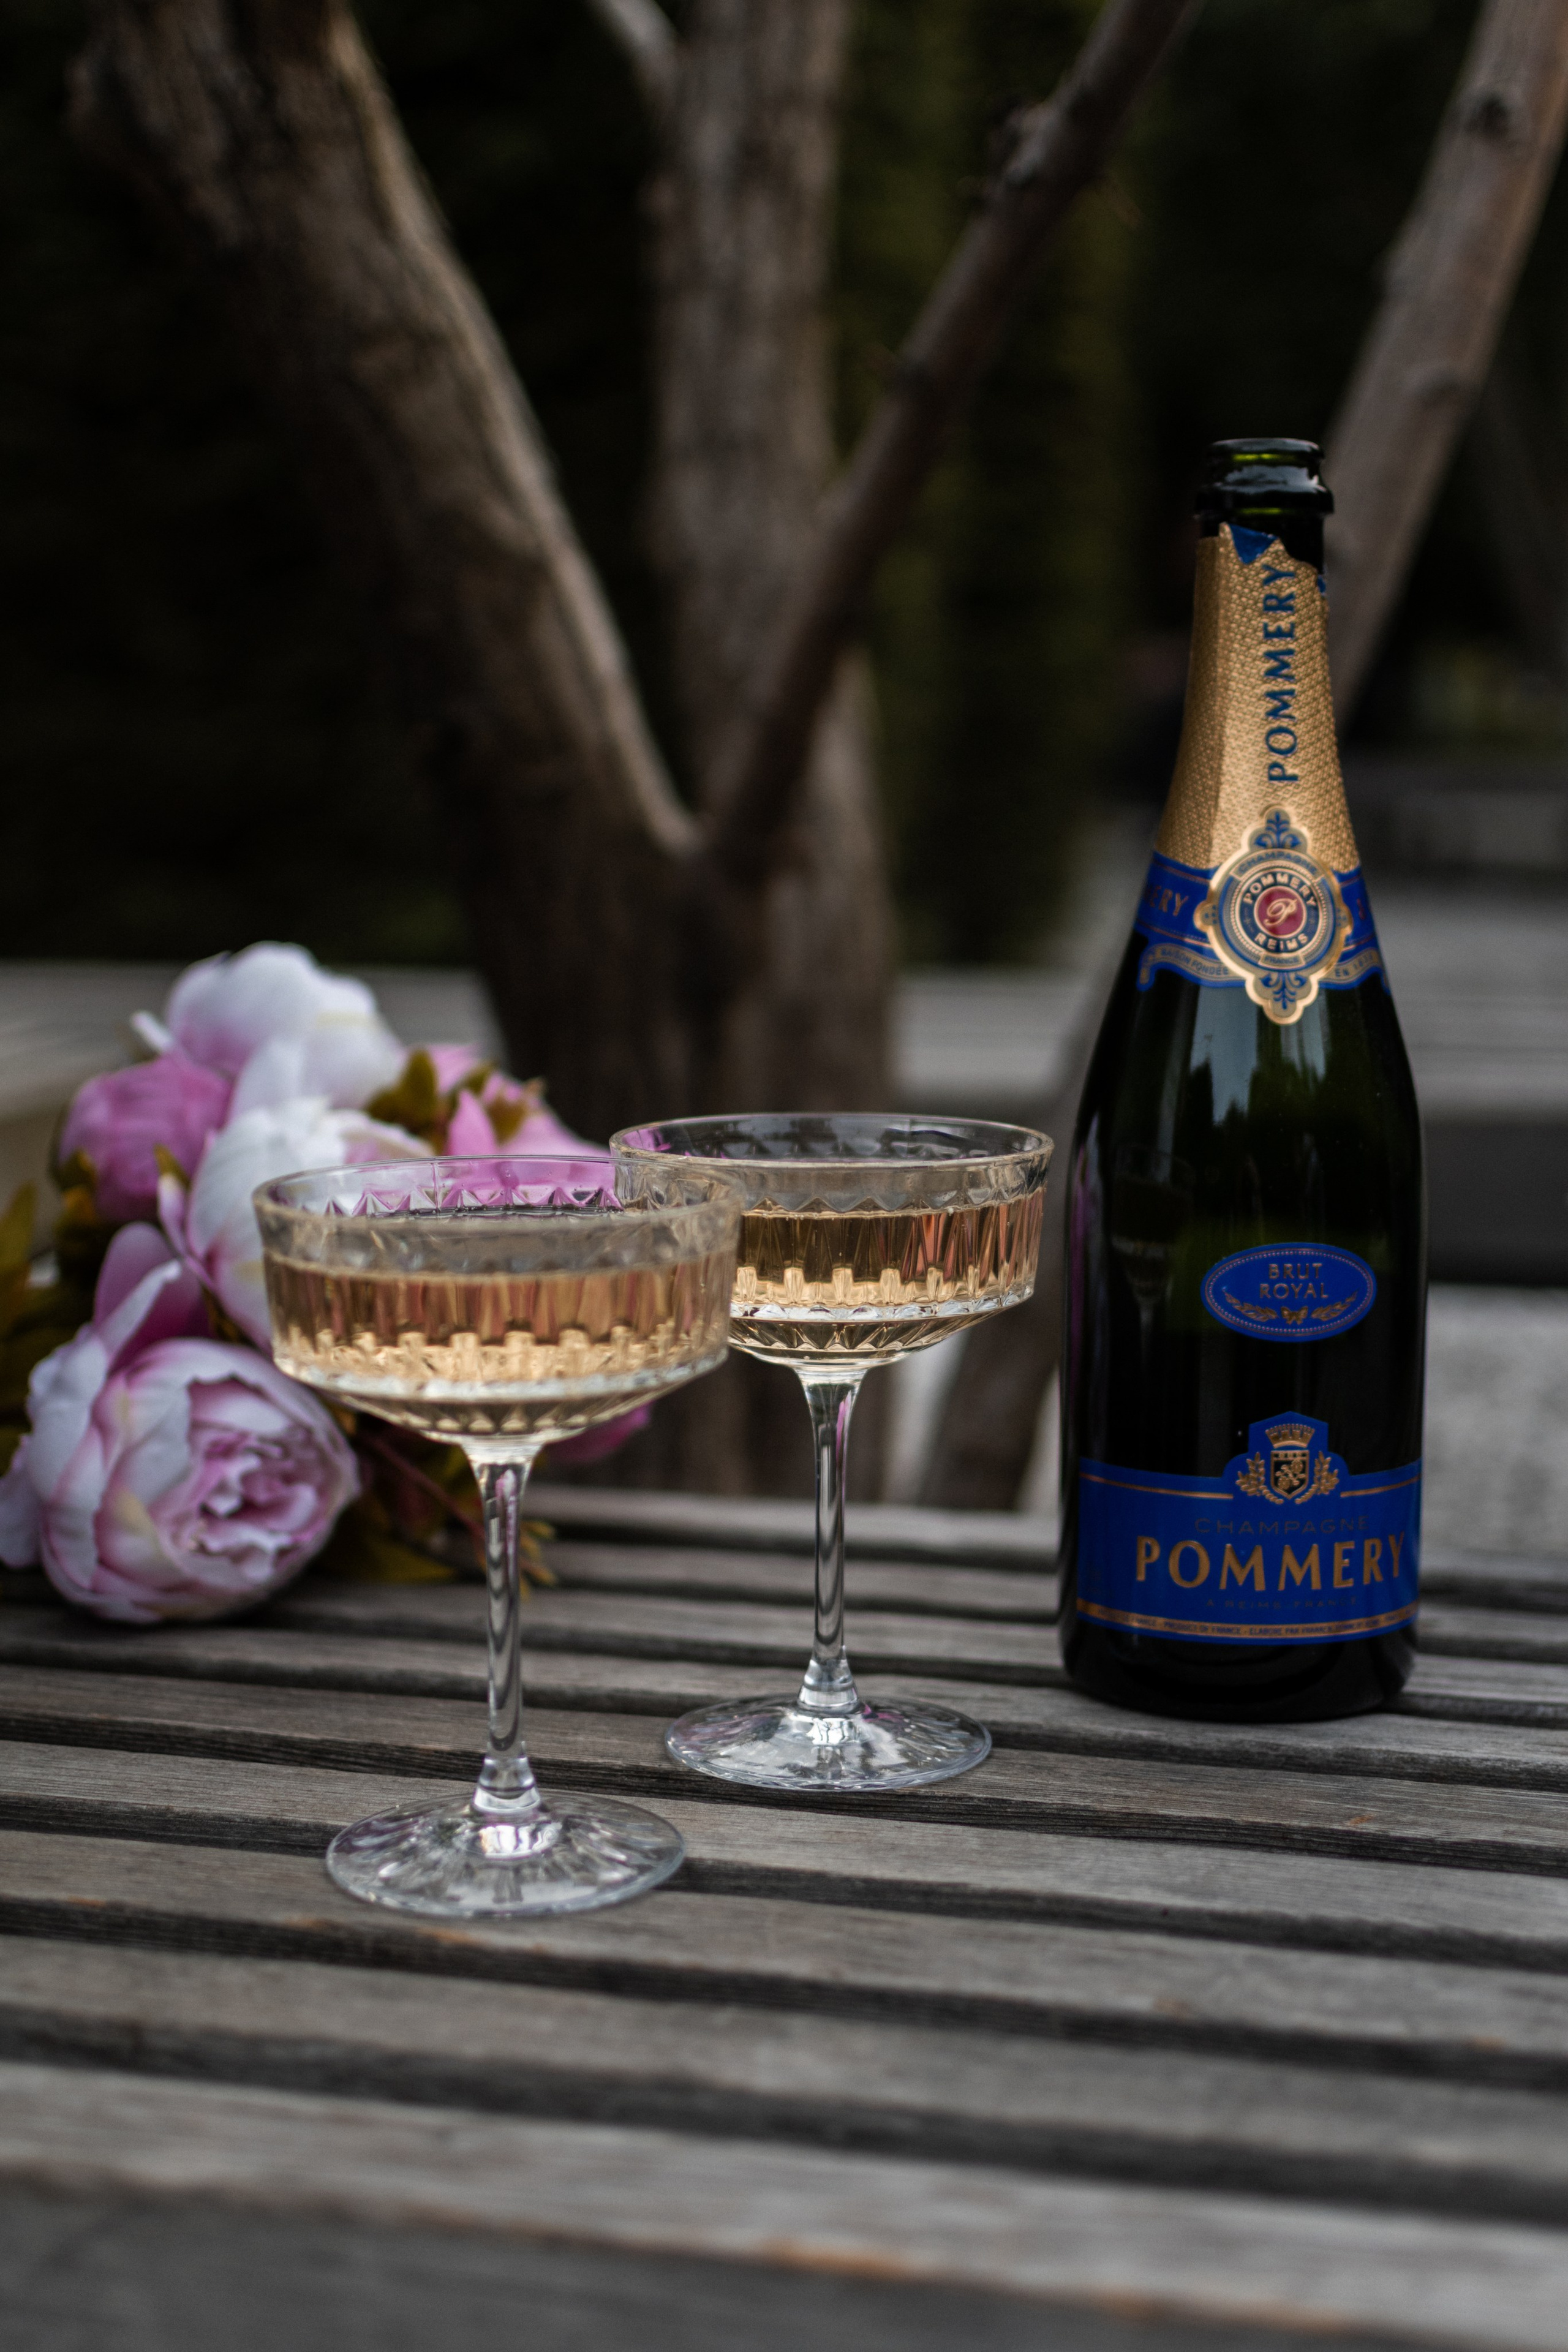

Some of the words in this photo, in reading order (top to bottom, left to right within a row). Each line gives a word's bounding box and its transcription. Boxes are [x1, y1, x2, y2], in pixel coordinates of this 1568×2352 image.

[1262, 564, 1298, 783] POMMERY
[1238, 850, 1317, 876] CHAMPAGNE
[1243, 873, 1317, 907] POMMERY
[1254, 932, 1309, 951] REIMS
[1268, 1263, 1322, 1279] BRUT
[1259, 1283, 1329, 1299] ROYAL
[1194, 1515, 1370, 1535] CHAMPAGNE
[1136, 1531, 1404, 1591] POMMERY
[1224, 1599, 1282, 1610] REIMS
